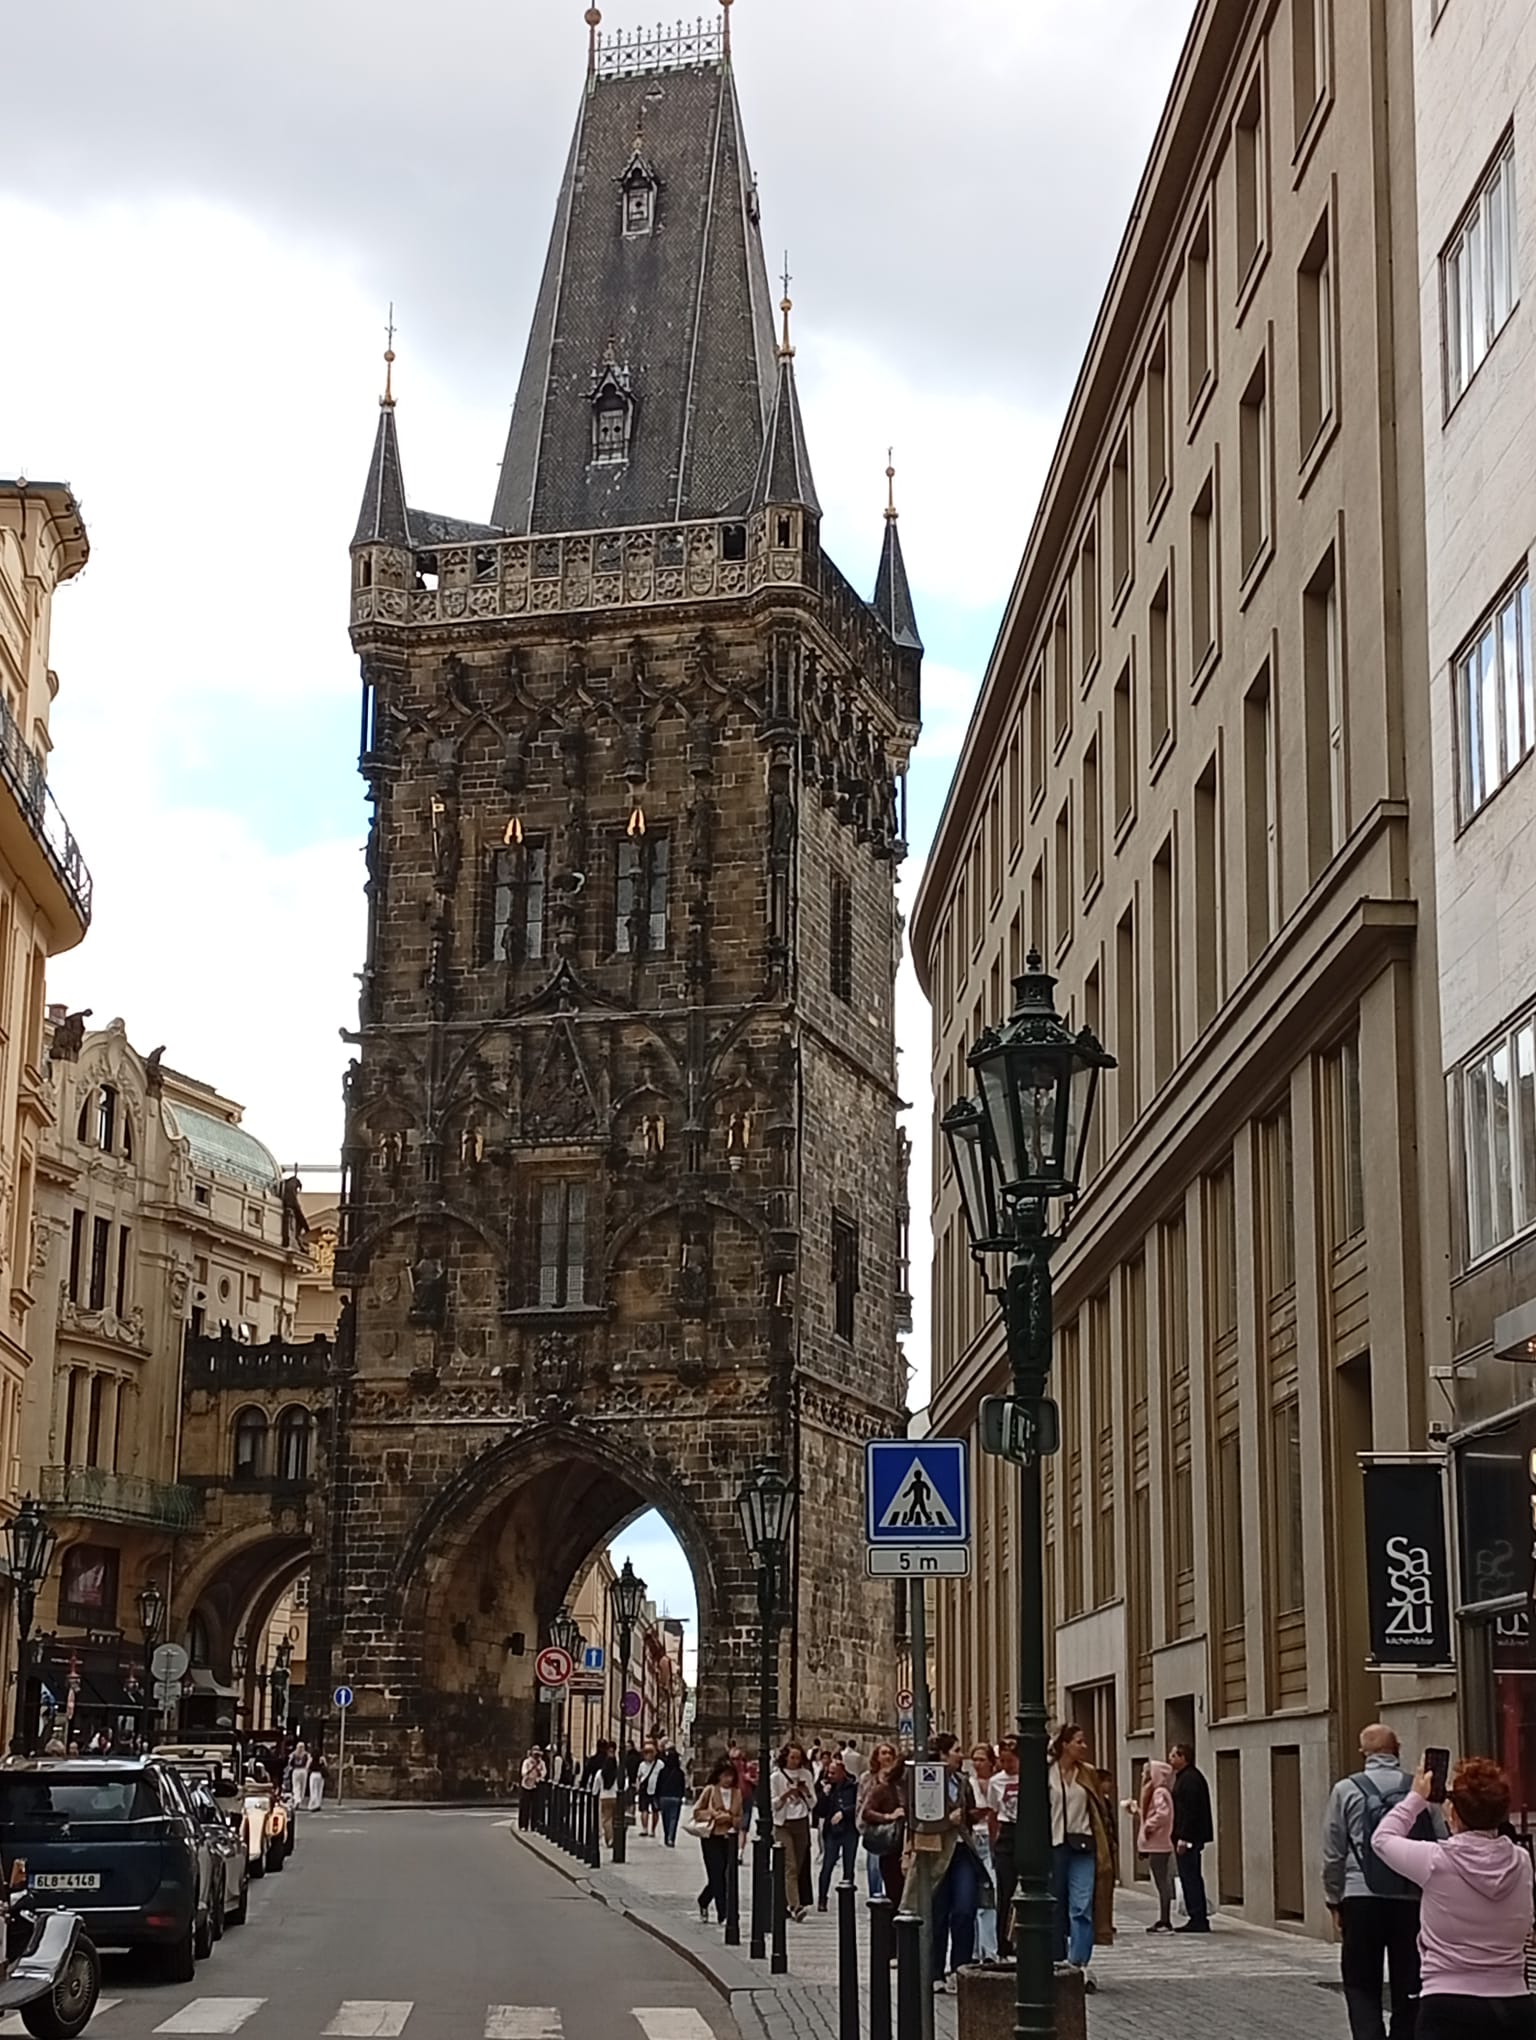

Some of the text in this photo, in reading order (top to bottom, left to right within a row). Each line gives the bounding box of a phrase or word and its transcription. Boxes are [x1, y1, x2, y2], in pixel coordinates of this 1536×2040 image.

[900, 1553, 938, 1570] 5 m
[1386, 1536, 1432, 1575] Sa
[67, 1875, 95, 1887] 4148
